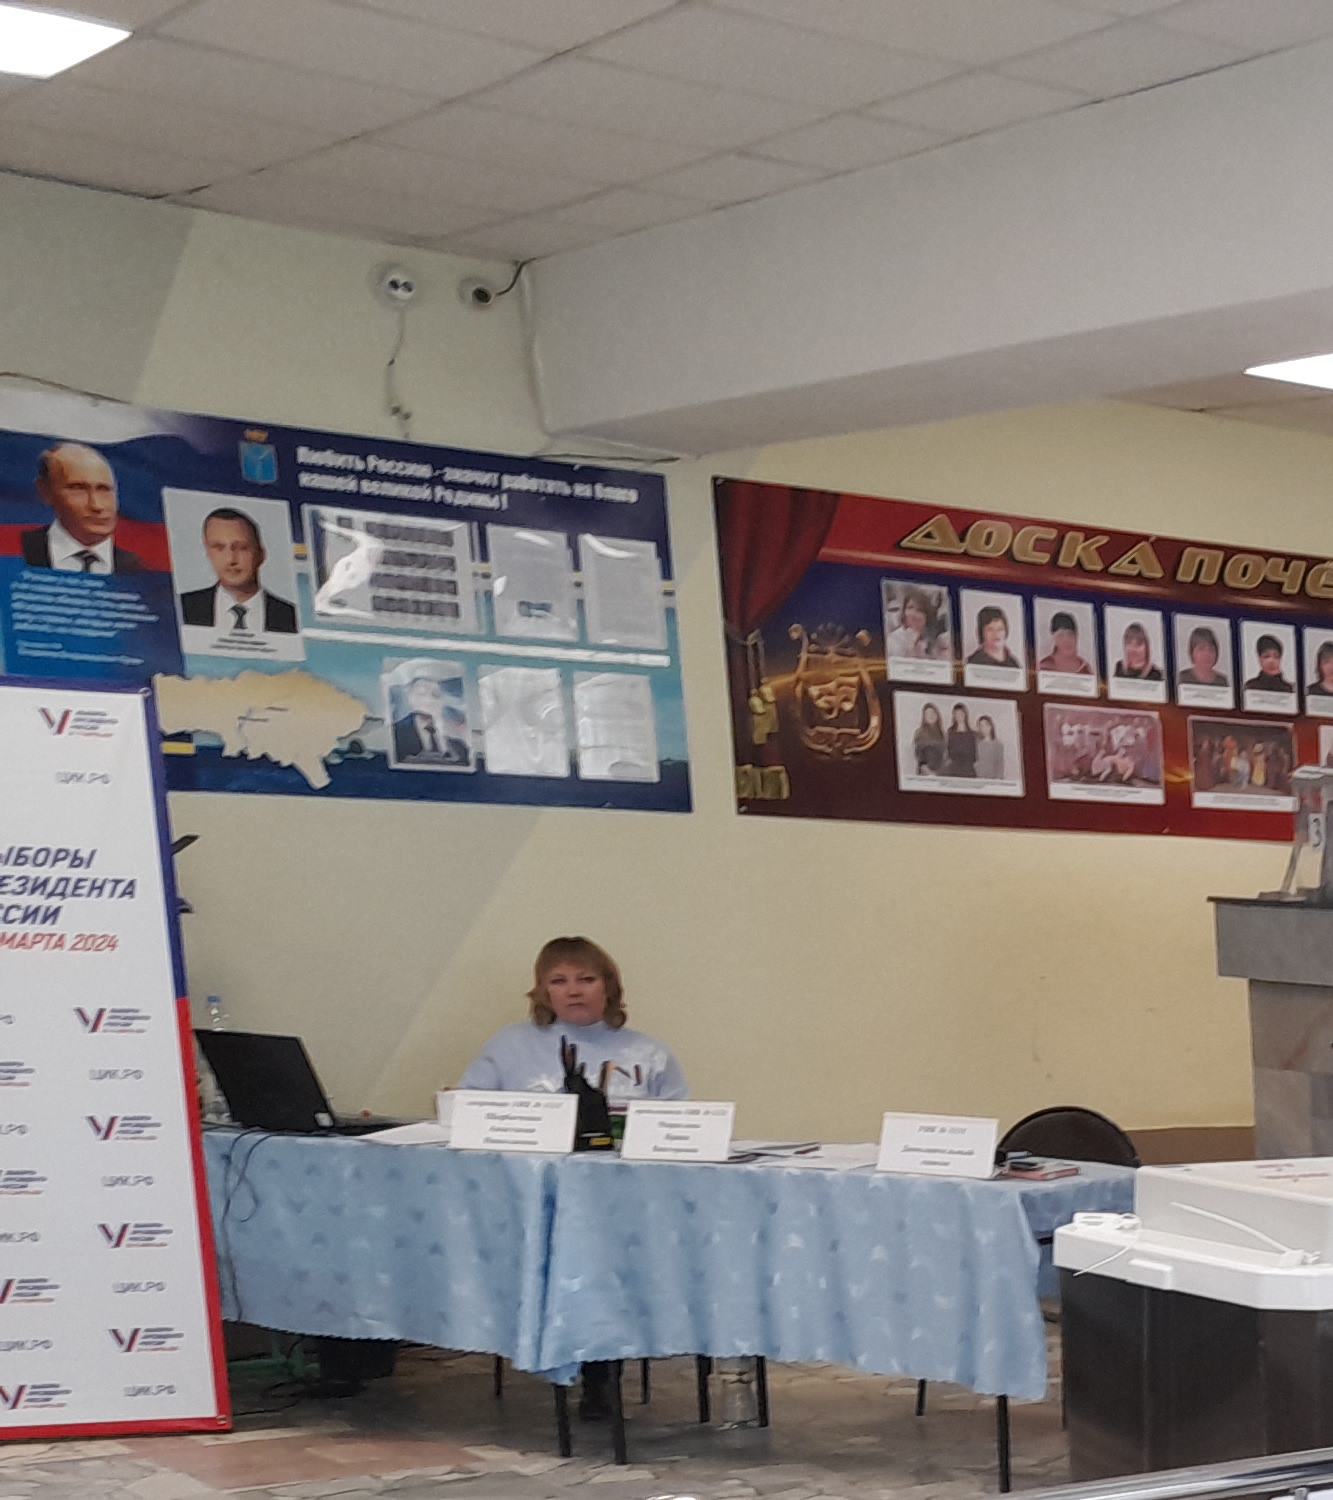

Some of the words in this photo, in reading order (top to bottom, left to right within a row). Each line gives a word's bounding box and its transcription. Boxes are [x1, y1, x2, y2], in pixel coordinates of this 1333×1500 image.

[899, 514, 1165, 578] ДОСКА
[0, 846, 97, 869] ЫБОРЫ
[0, 875, 137, 901] ЕЗИДЕНТА
[68, 933, 119, 952] 2024
